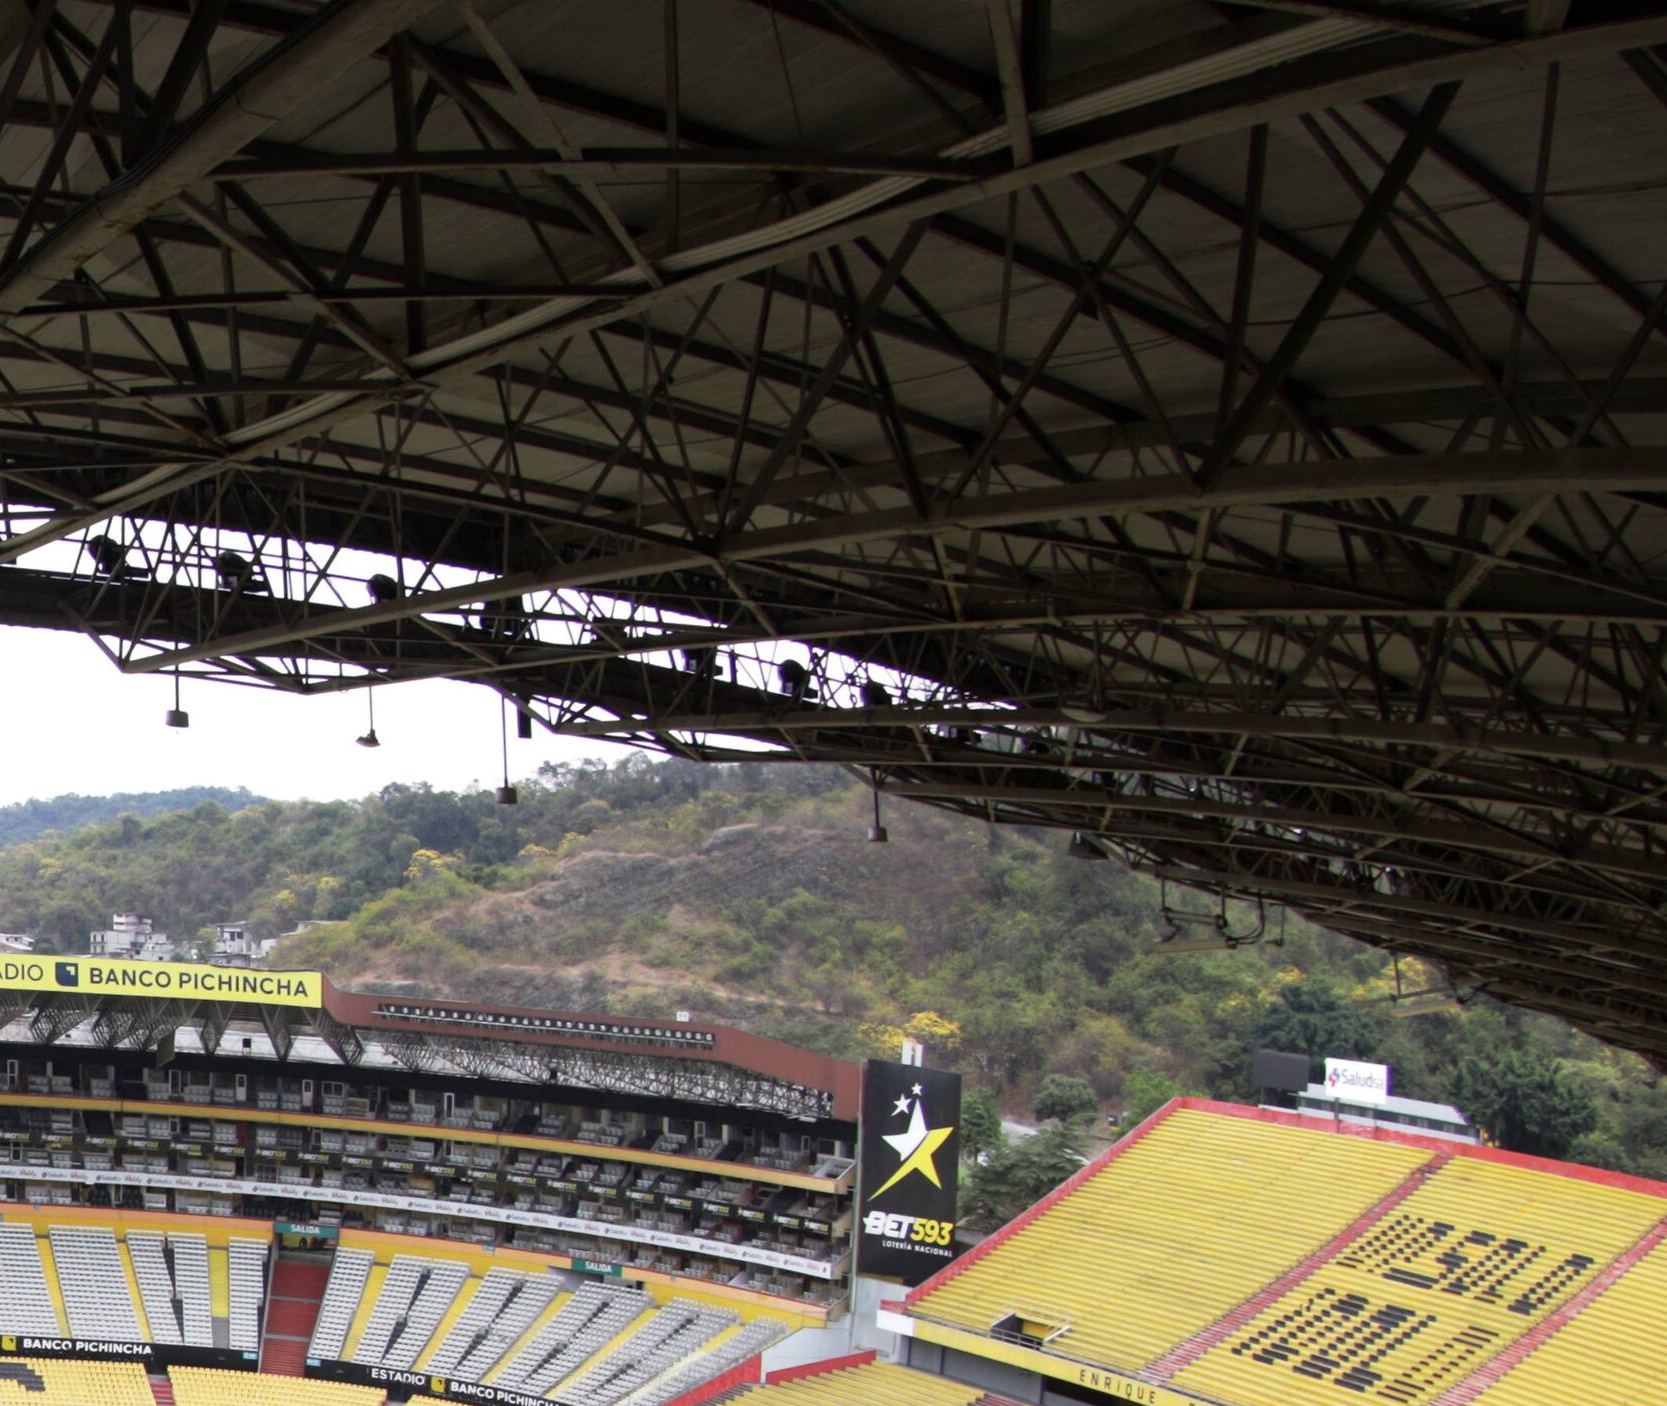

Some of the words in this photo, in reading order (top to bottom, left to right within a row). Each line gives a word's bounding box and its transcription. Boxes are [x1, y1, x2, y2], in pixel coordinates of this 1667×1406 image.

[89, 966, 172, 989] BANCO
[178, 971, 308, 999] PICHINCHA
[290, 1225, 320, 1235] SALIDA
[863, 1210, 954, 1246] BET593
[914, 1245, 952, 1257] NACIONAL
[584, 1262, 612, 1275] SALIDA
[23, 1338, 72, 1351] BANCO
[75, 1340, 152, 1355] PICHINCHA
[370, 1367, 426, 1386] ESTADIO
[450, 1381, 495, 1401] BANCO
[1078, 1368, 1157, 1405] ENRIQUE
